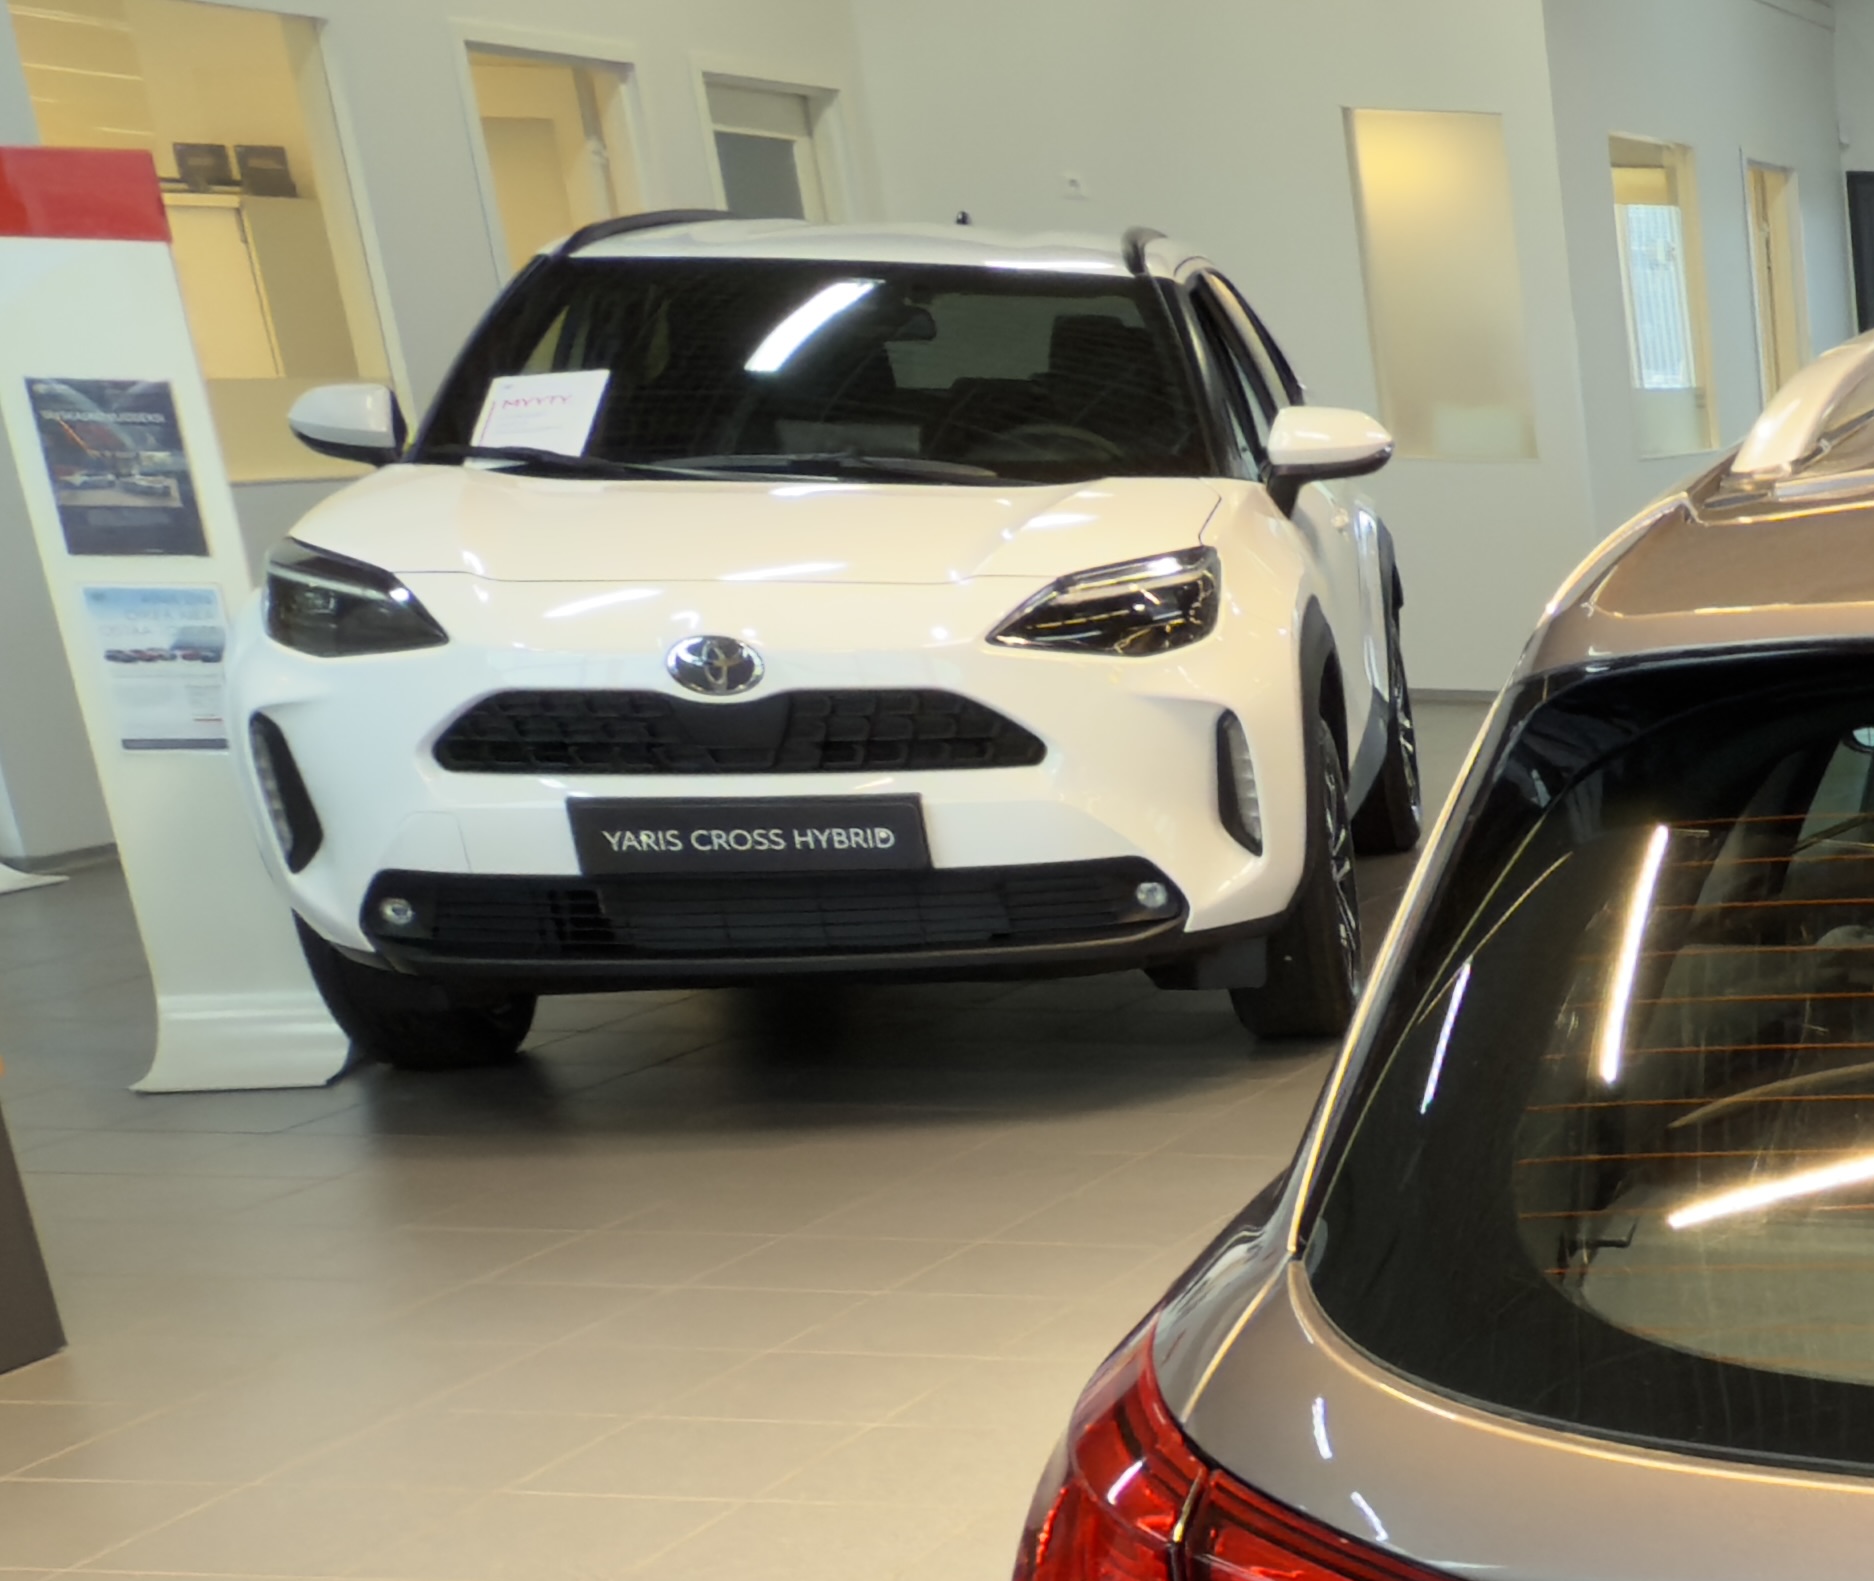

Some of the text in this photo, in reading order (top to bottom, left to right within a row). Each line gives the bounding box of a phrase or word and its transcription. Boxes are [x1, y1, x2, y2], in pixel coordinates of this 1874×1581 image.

[602, 828, 895, 851] YARIS CROSS HYBRID
